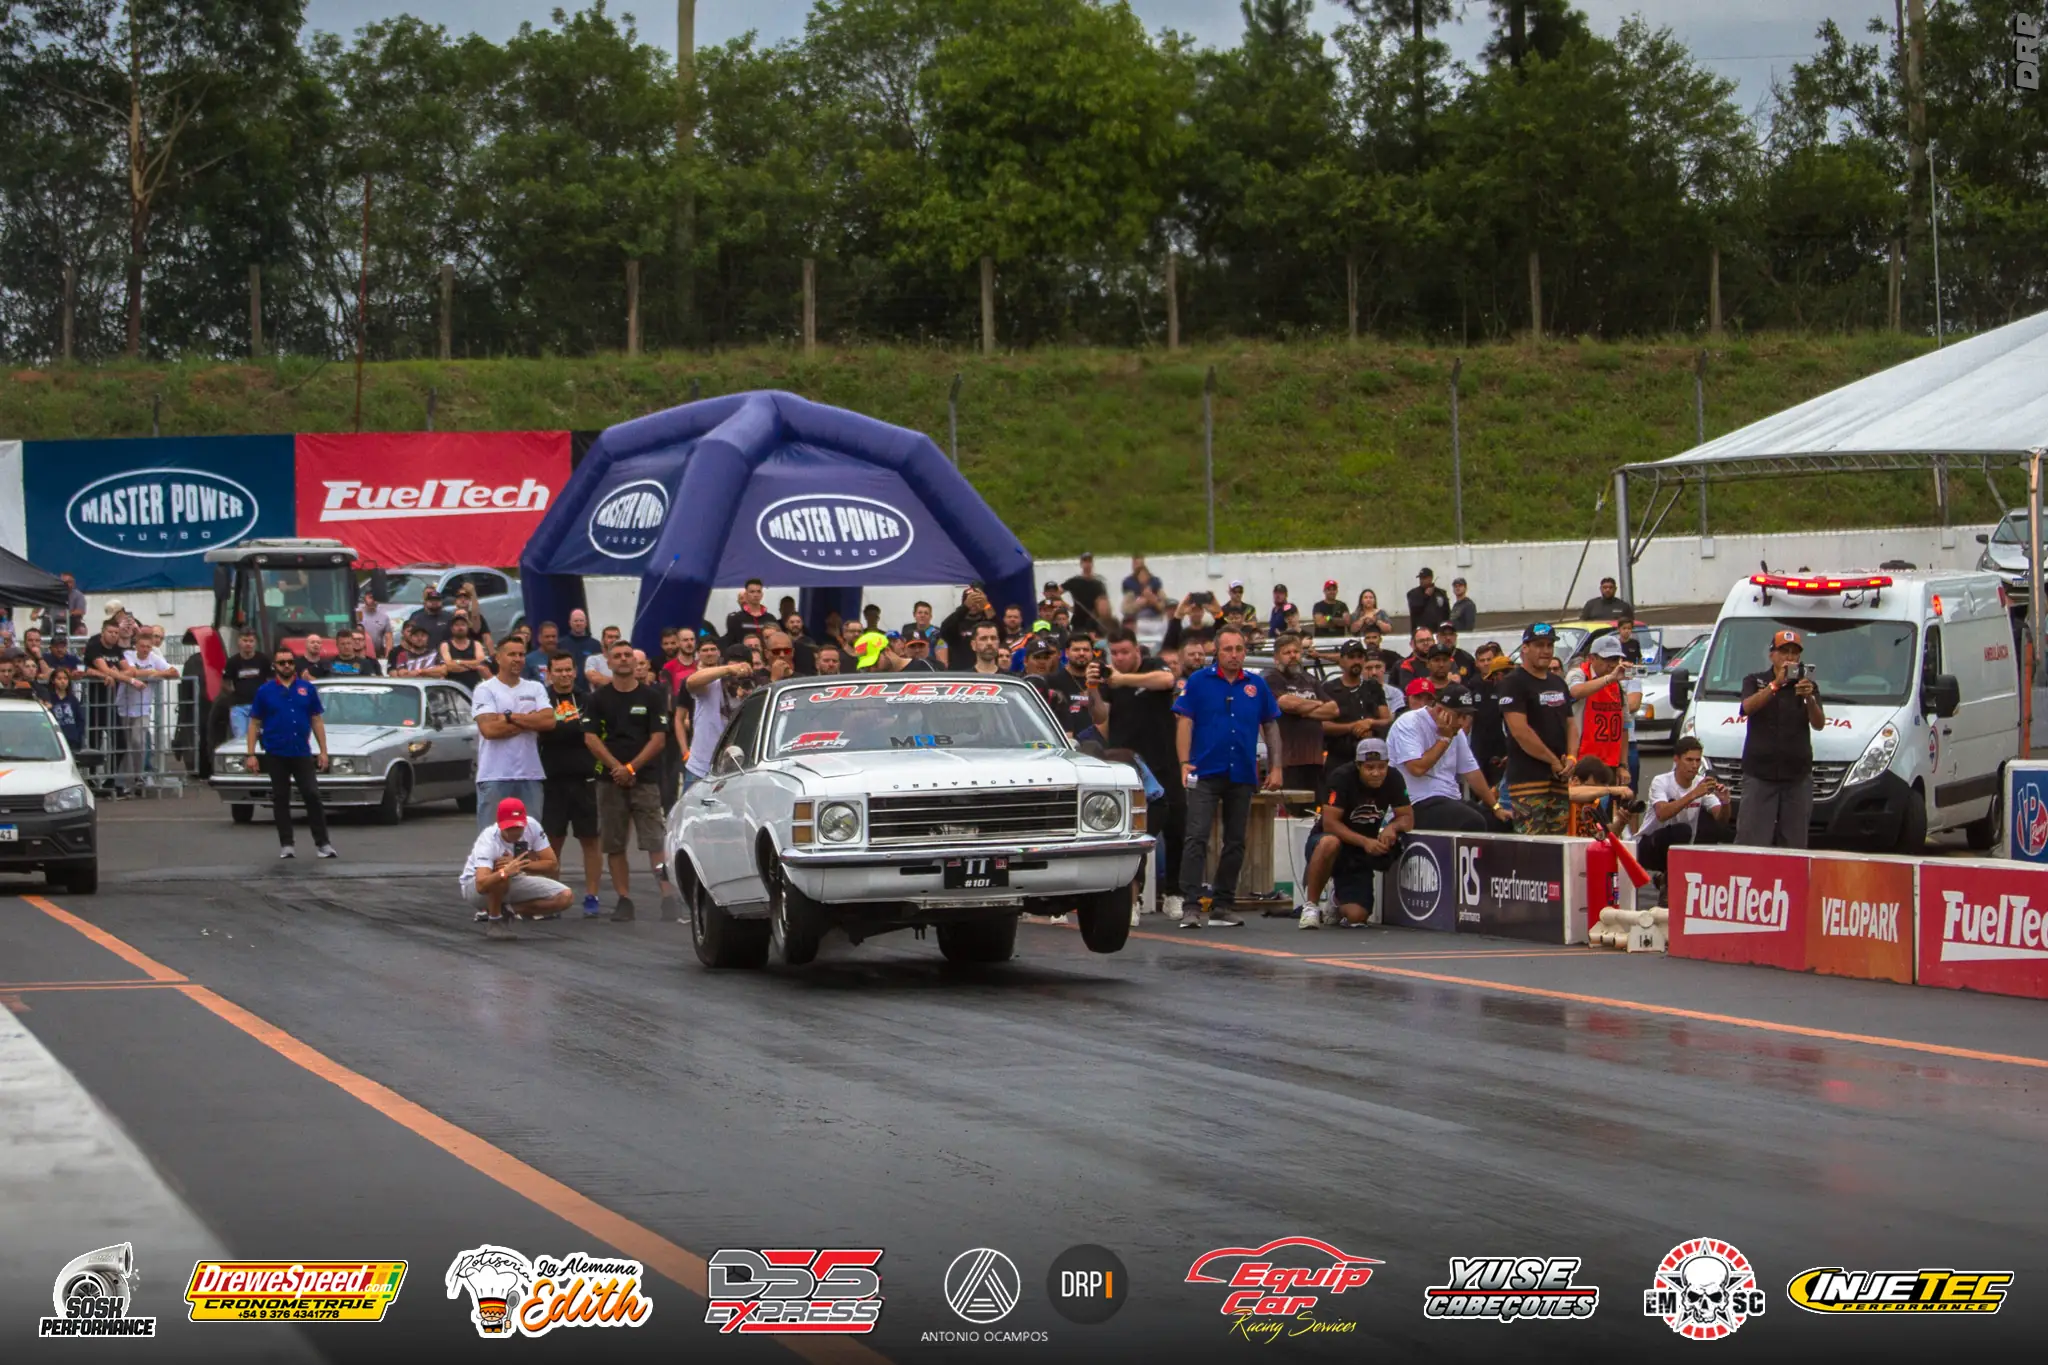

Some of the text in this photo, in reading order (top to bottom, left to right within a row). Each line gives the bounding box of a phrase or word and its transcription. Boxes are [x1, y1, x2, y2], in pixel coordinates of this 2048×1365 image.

[81, 484, 243, 526] MASTER POWER
[320, 479, 550, 521] FuelTech
[597, 492, 664, 528] MASTER POWER
[117, 531, 211, 541] TURBO
[768, 506, 900, 543] MASTER POWER
[801, 549, 878, 557] TURBO
[809, 682, 1003, 703] JULIETA
[1594, 713, 1622, 742] 20
[893, 777, 1053, 790] CHEVROLET
[965, 857, 990, 875] TT
[964, 878, 991, 888] #101
[1684, 872, 1789, 935] FuelTech
[1822, 897, 1900, 944] VELOPARK
